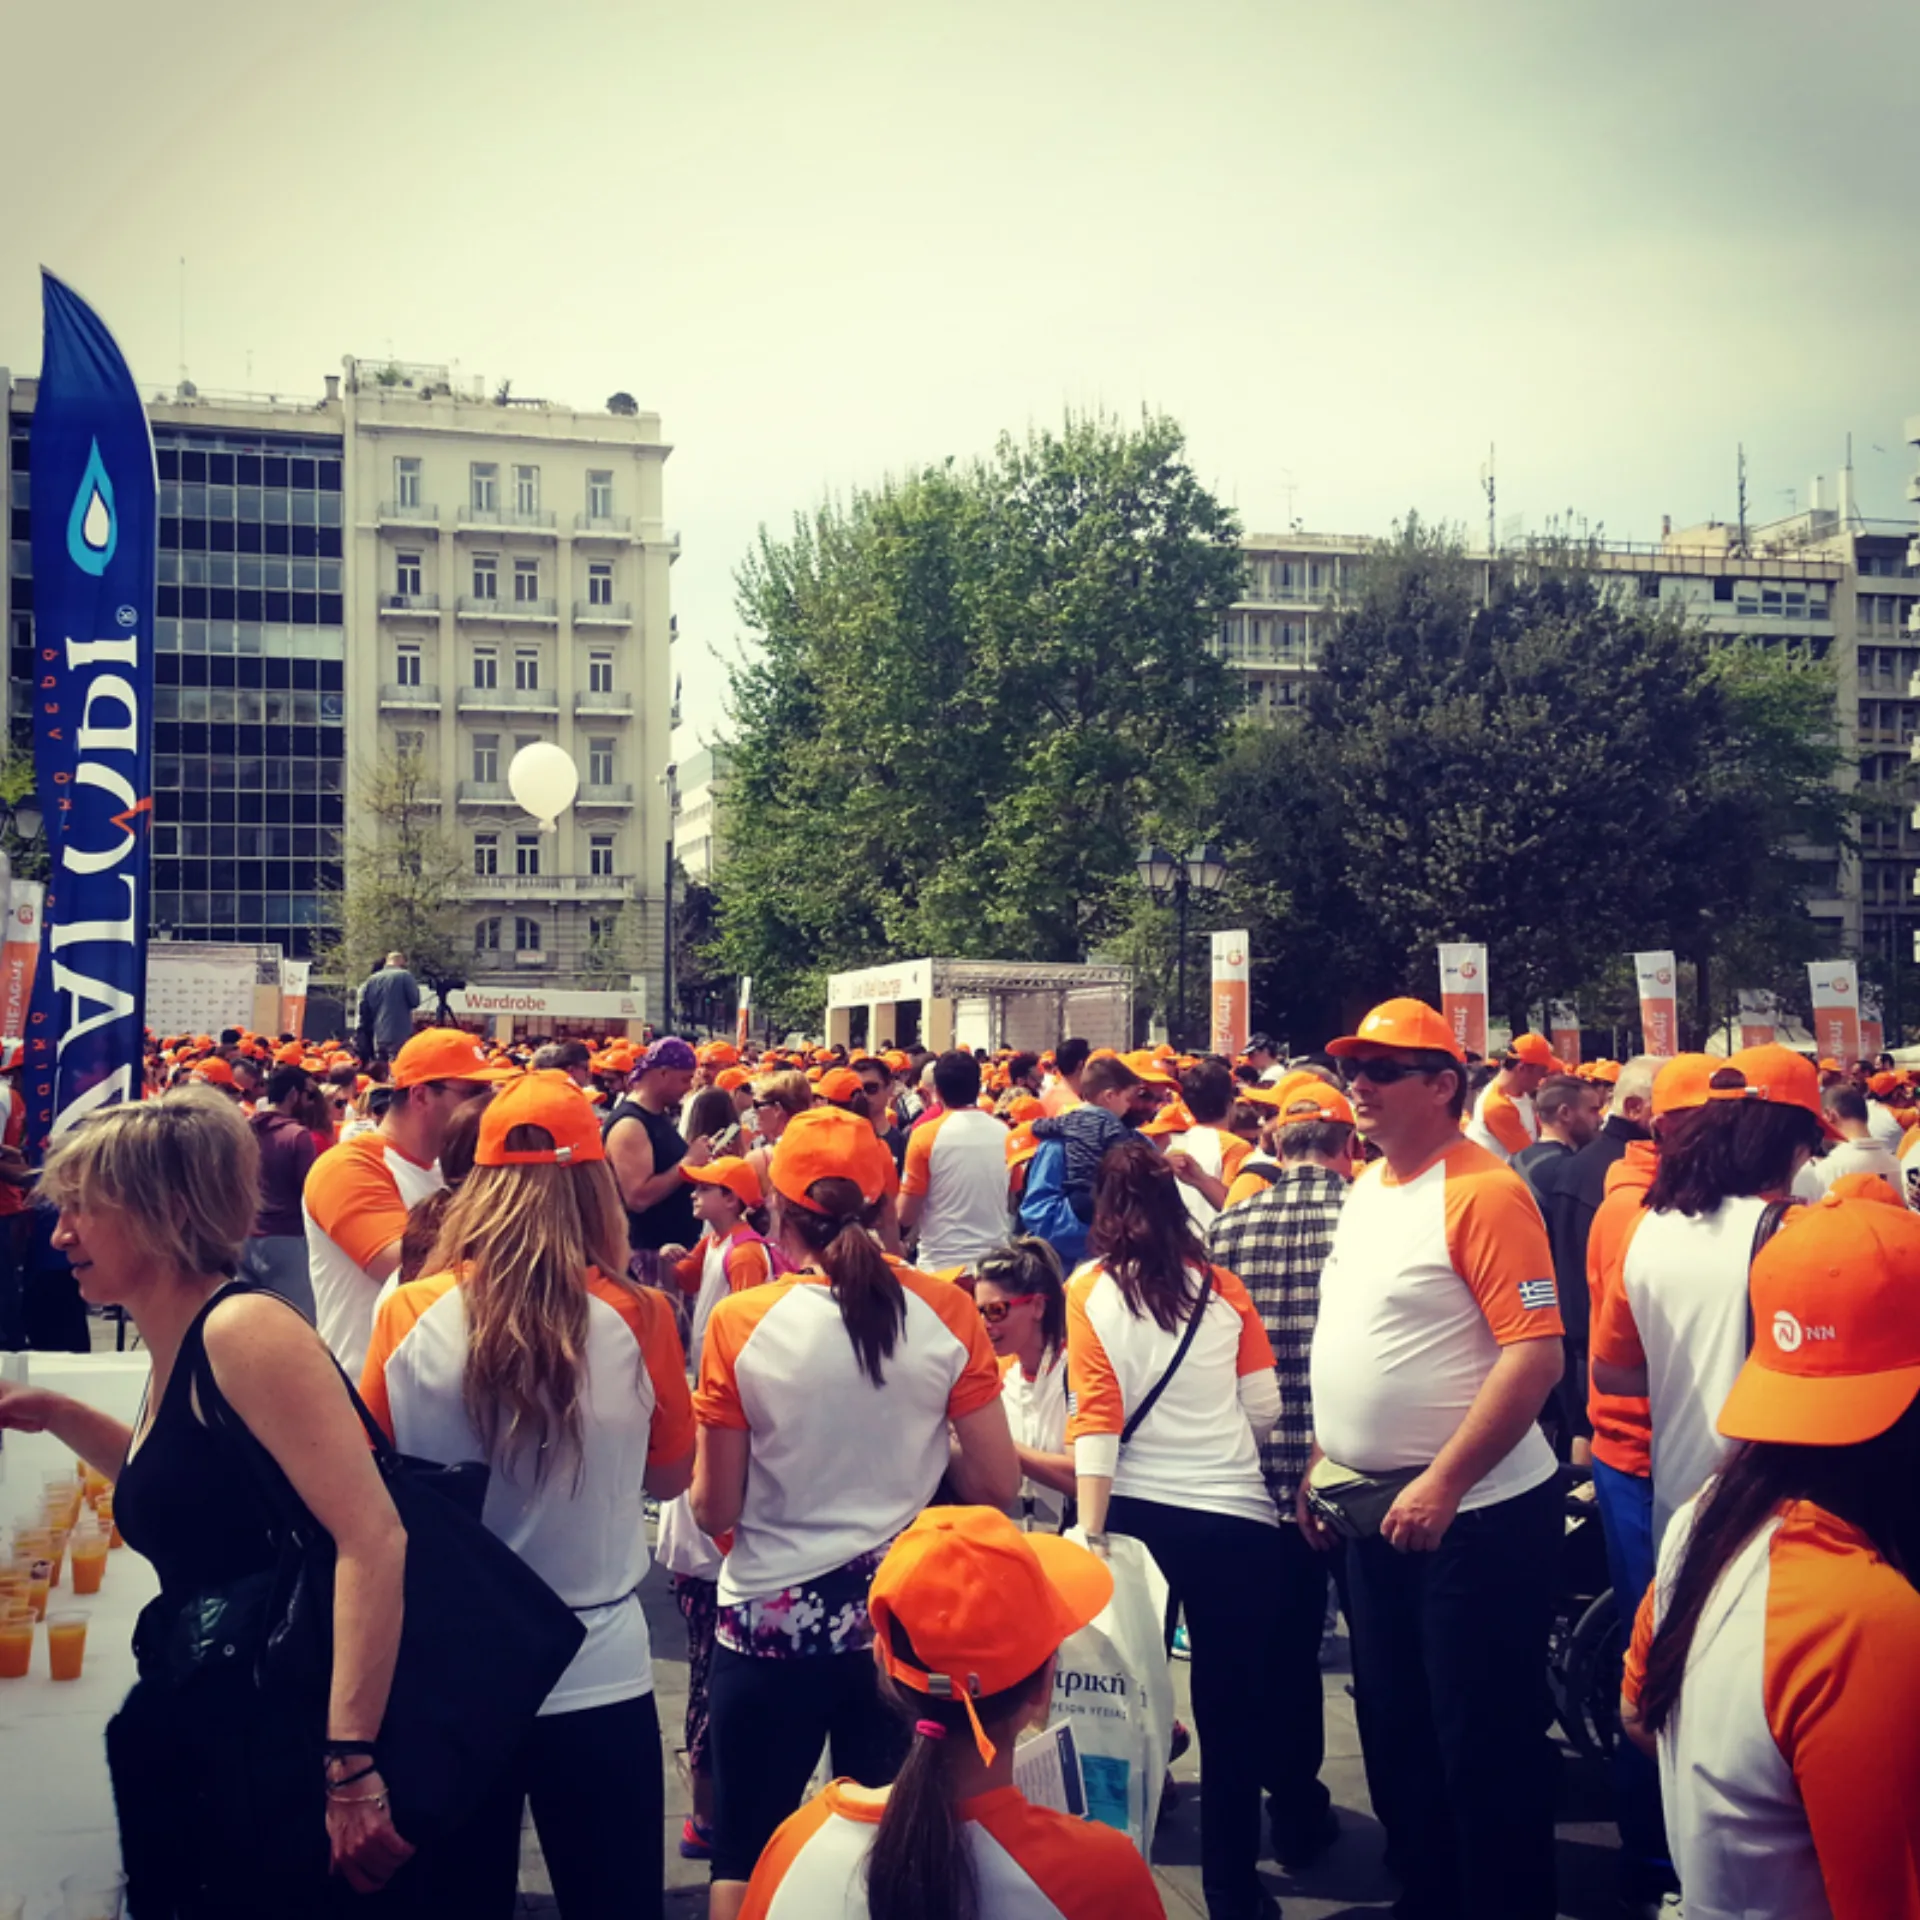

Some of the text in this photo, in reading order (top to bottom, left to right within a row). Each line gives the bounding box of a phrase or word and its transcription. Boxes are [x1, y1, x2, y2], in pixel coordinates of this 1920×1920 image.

[465, 992, 546, 1010] Wardrobe
[1806, 1325, 1836, 1341] NN
[1055, 1671, 1126, 1697] τρική
[1051, 1702, 1085, 1714] ΡΕΙΟΝ
